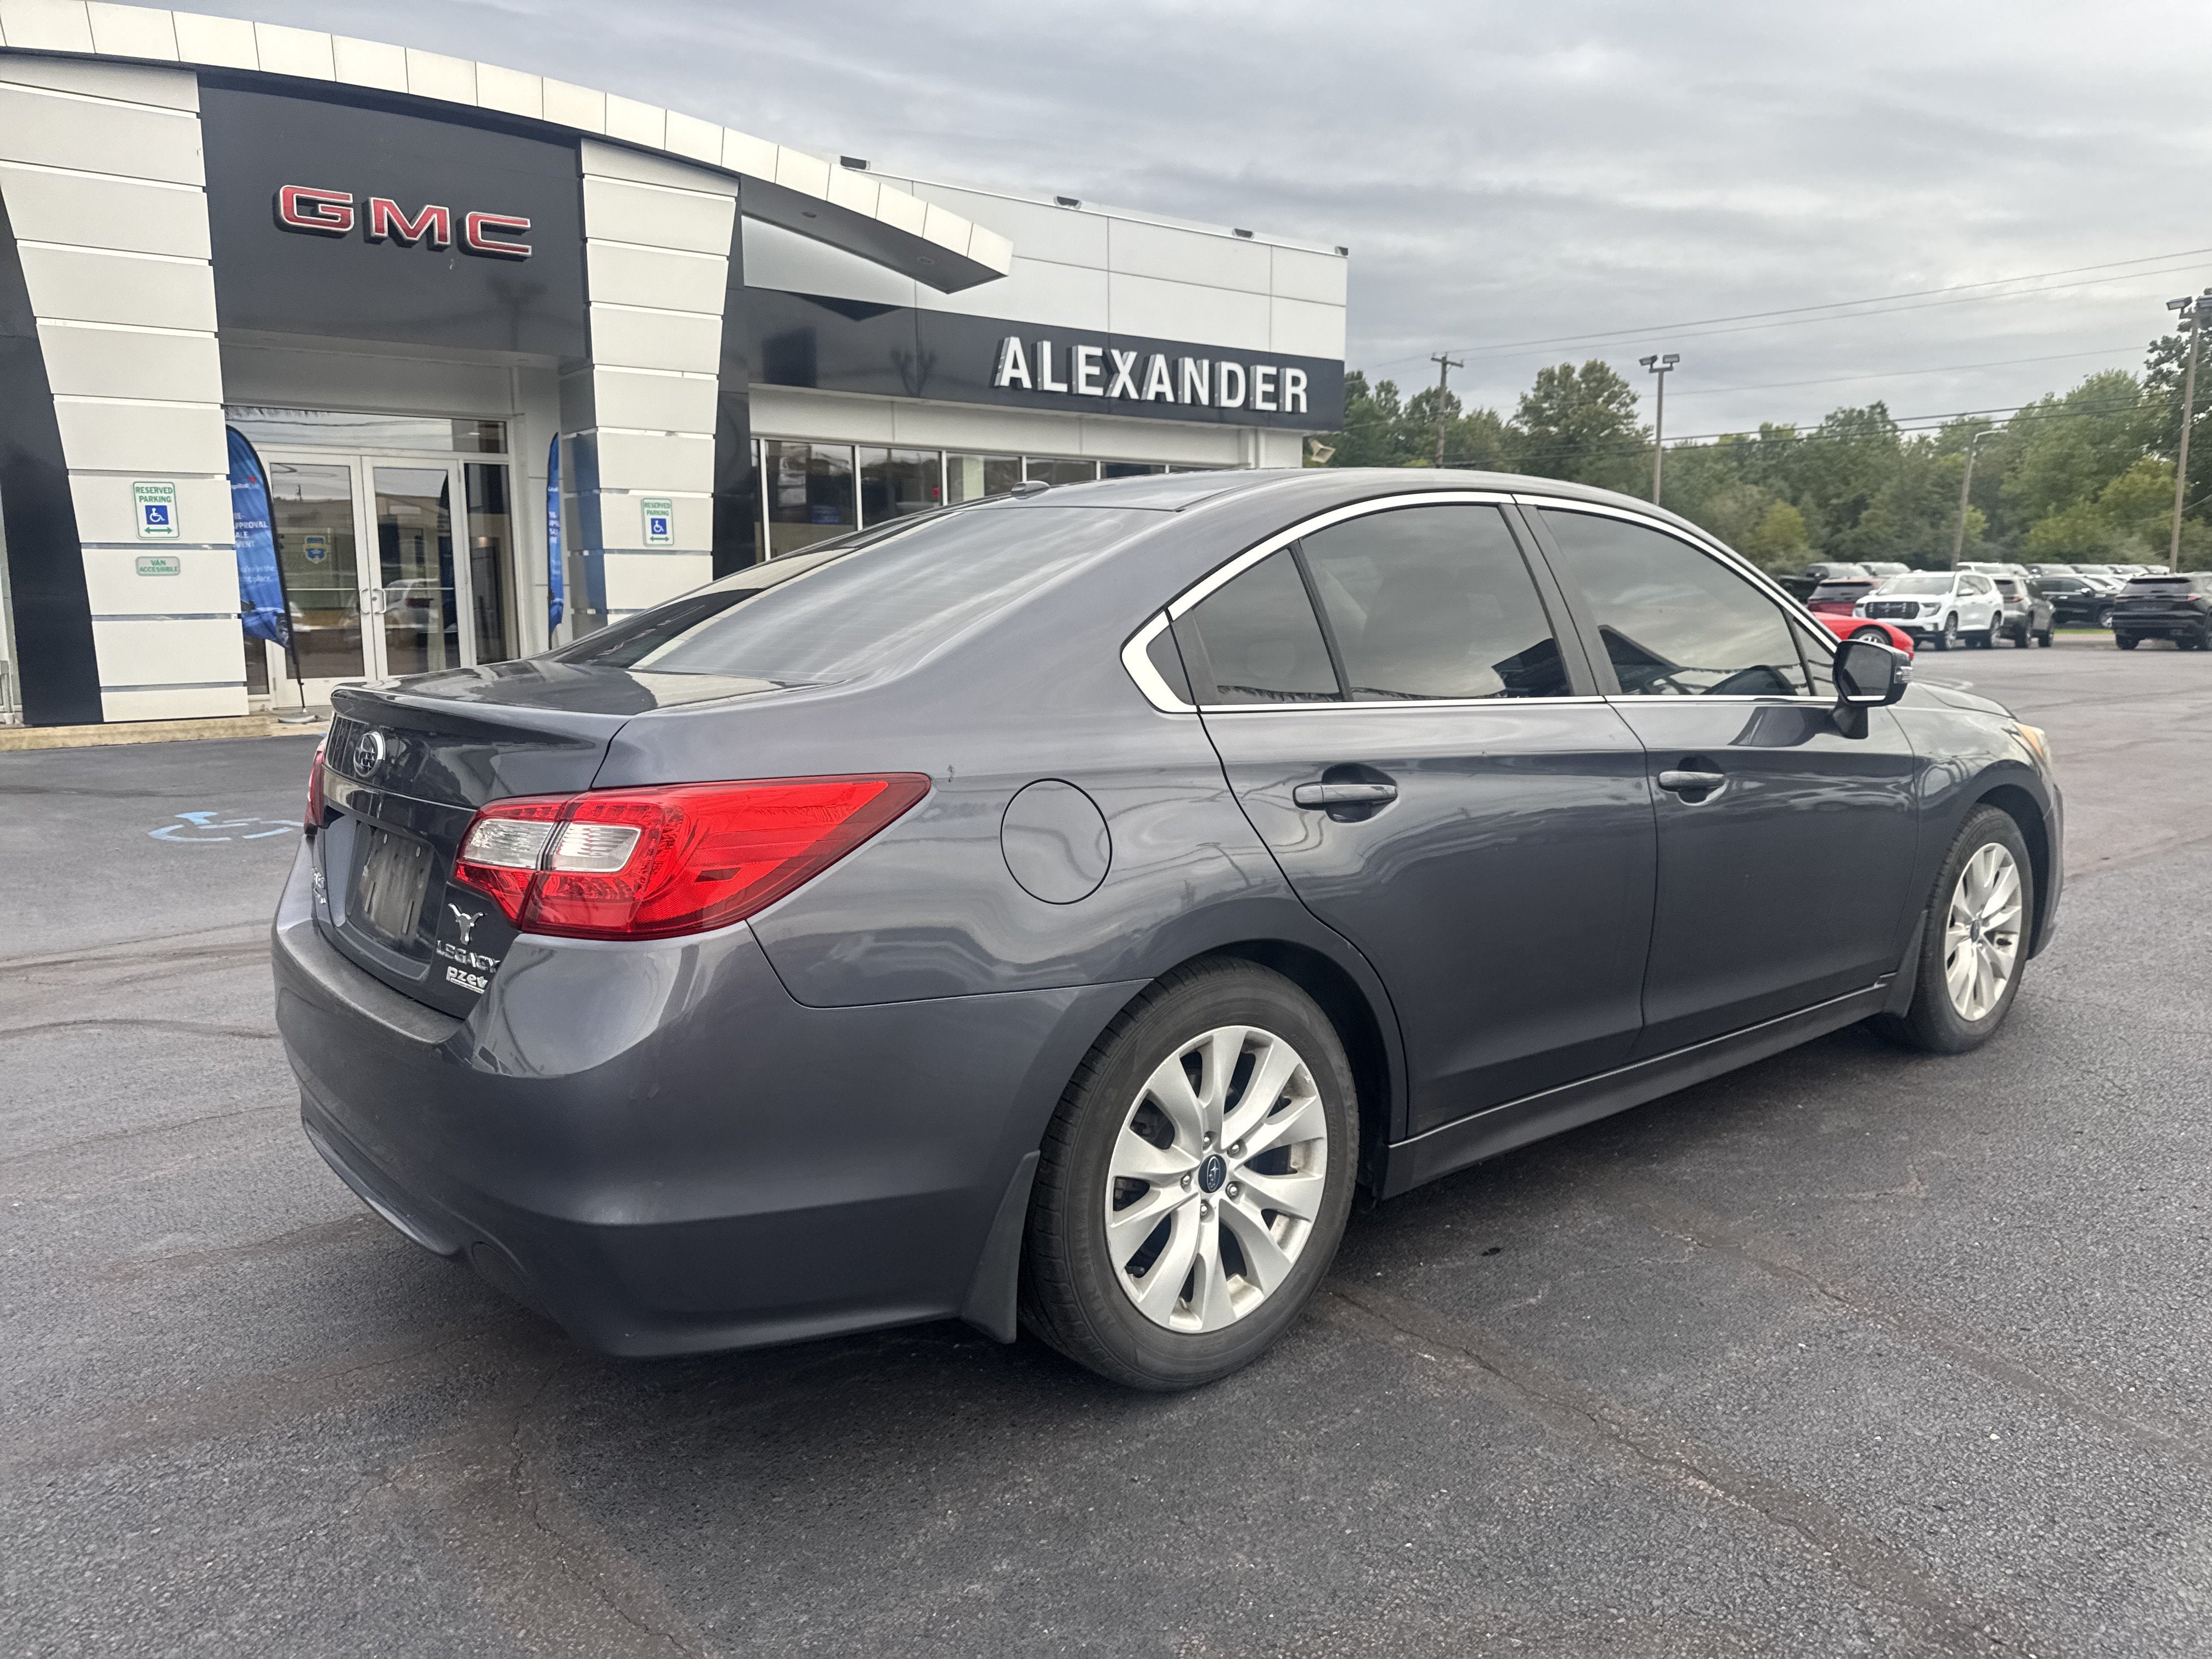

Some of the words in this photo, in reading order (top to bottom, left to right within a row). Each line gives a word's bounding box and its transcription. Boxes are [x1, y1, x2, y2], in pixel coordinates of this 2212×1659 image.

[279, 184, 532, 256] GMC
[995, 336, 1308, 413] ALEXANDER
[235, 521, 268, 529] PPROVAL
[436, 940, 500, 973] LEGACY
